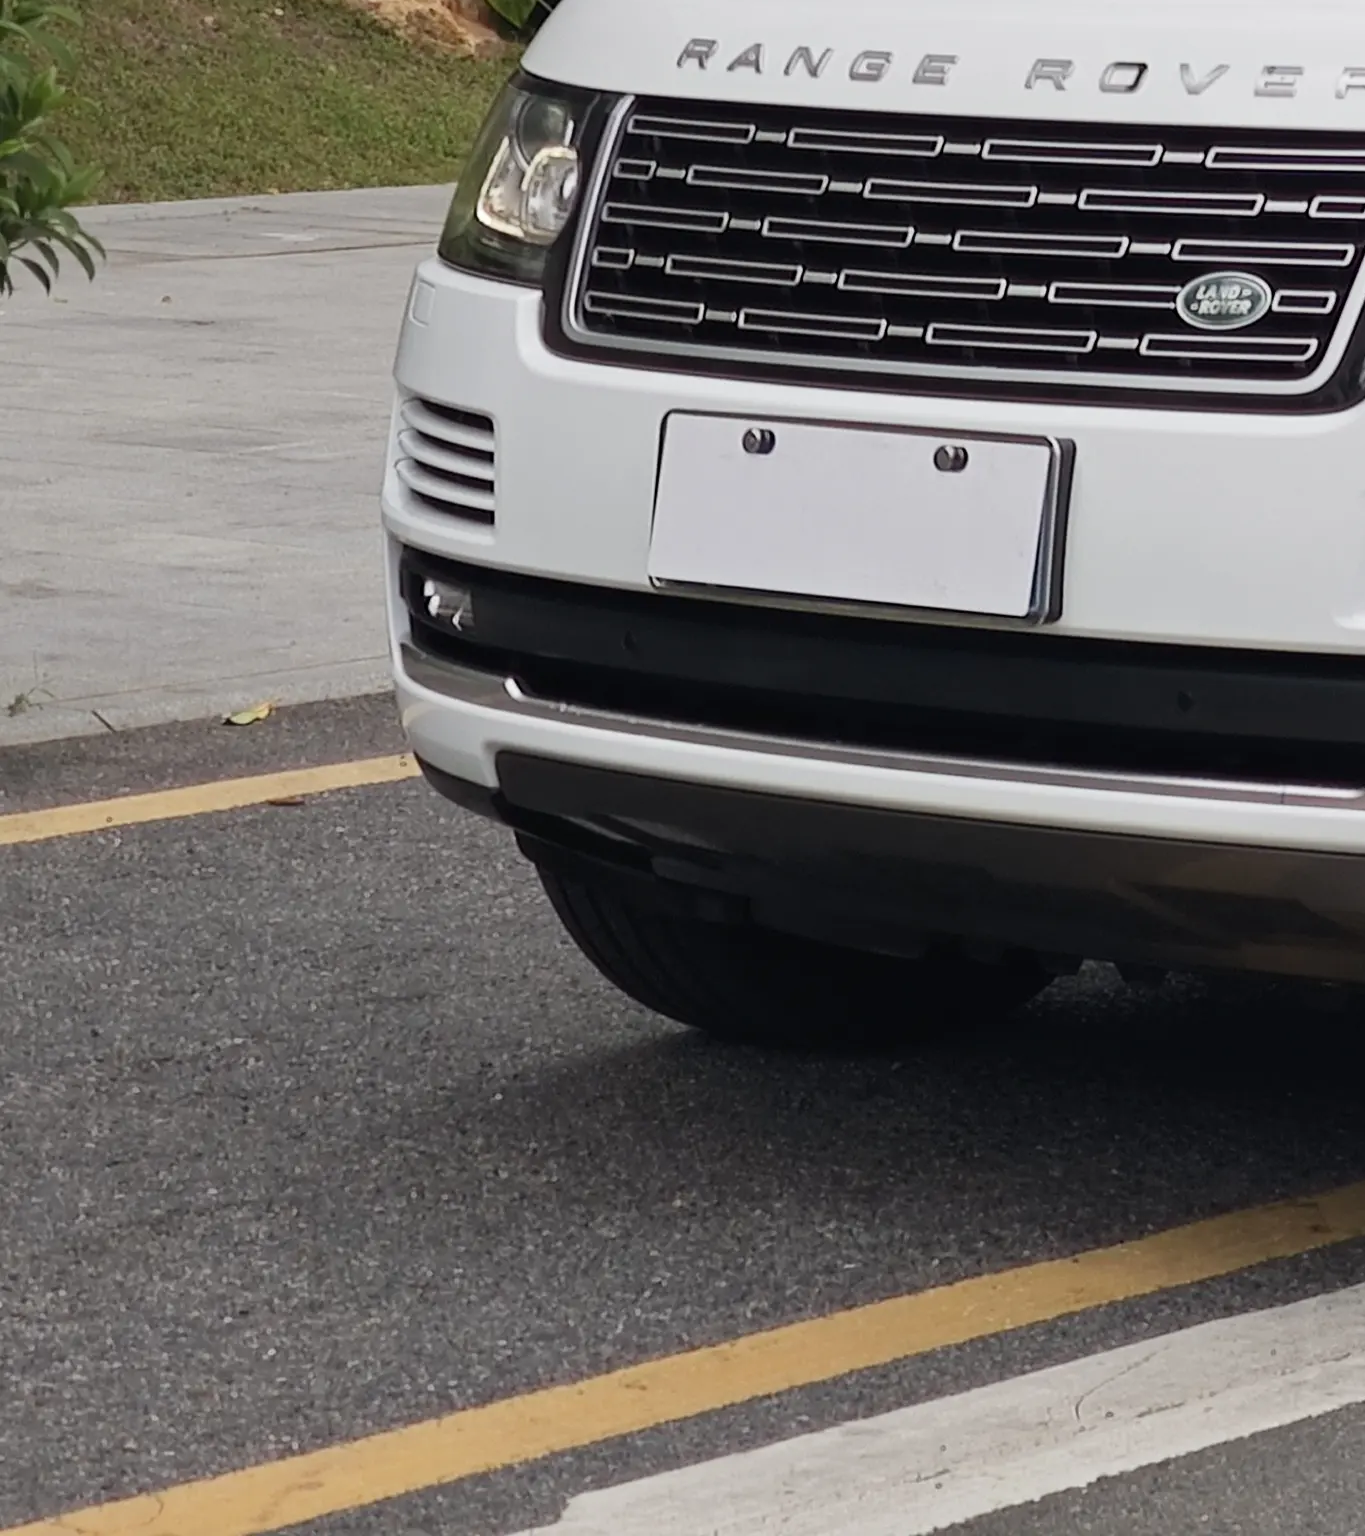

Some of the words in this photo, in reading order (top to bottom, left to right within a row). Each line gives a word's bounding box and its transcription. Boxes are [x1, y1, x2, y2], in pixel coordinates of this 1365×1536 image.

[676, 38, 959, 85] RANGE
[1196, 284, 1241, 300] LAND
[1198, 299, 1252, 315] ROVER
